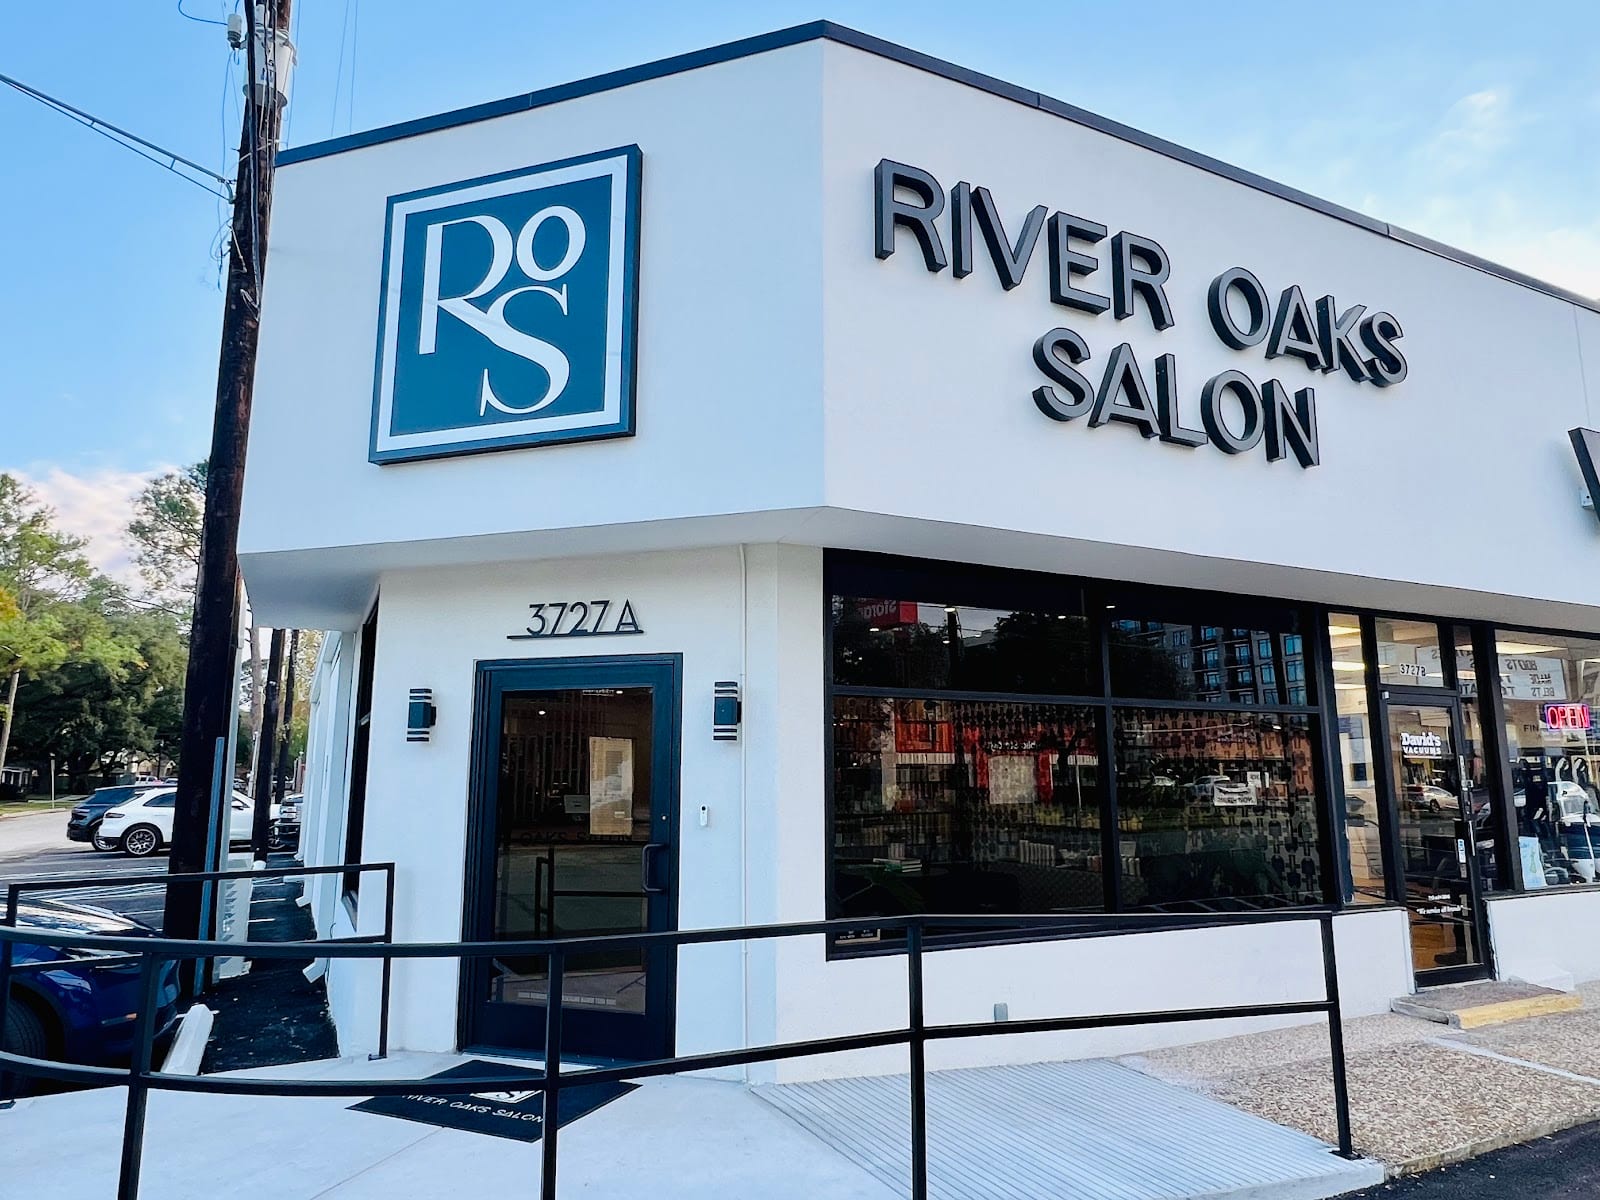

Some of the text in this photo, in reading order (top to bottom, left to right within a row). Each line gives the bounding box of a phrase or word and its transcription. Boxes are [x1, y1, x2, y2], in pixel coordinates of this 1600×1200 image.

[874, 158, 1407, 387] RIVER OAKS
[1032, 328, 1320, 468] SALON
[1547, 706, 1589, 729] OPEN
[1401, 731, 1441, 747] David's
[1402, 746, 1442, 756] VACUUMS
[449, 1101, 491, 1113] OAKS
